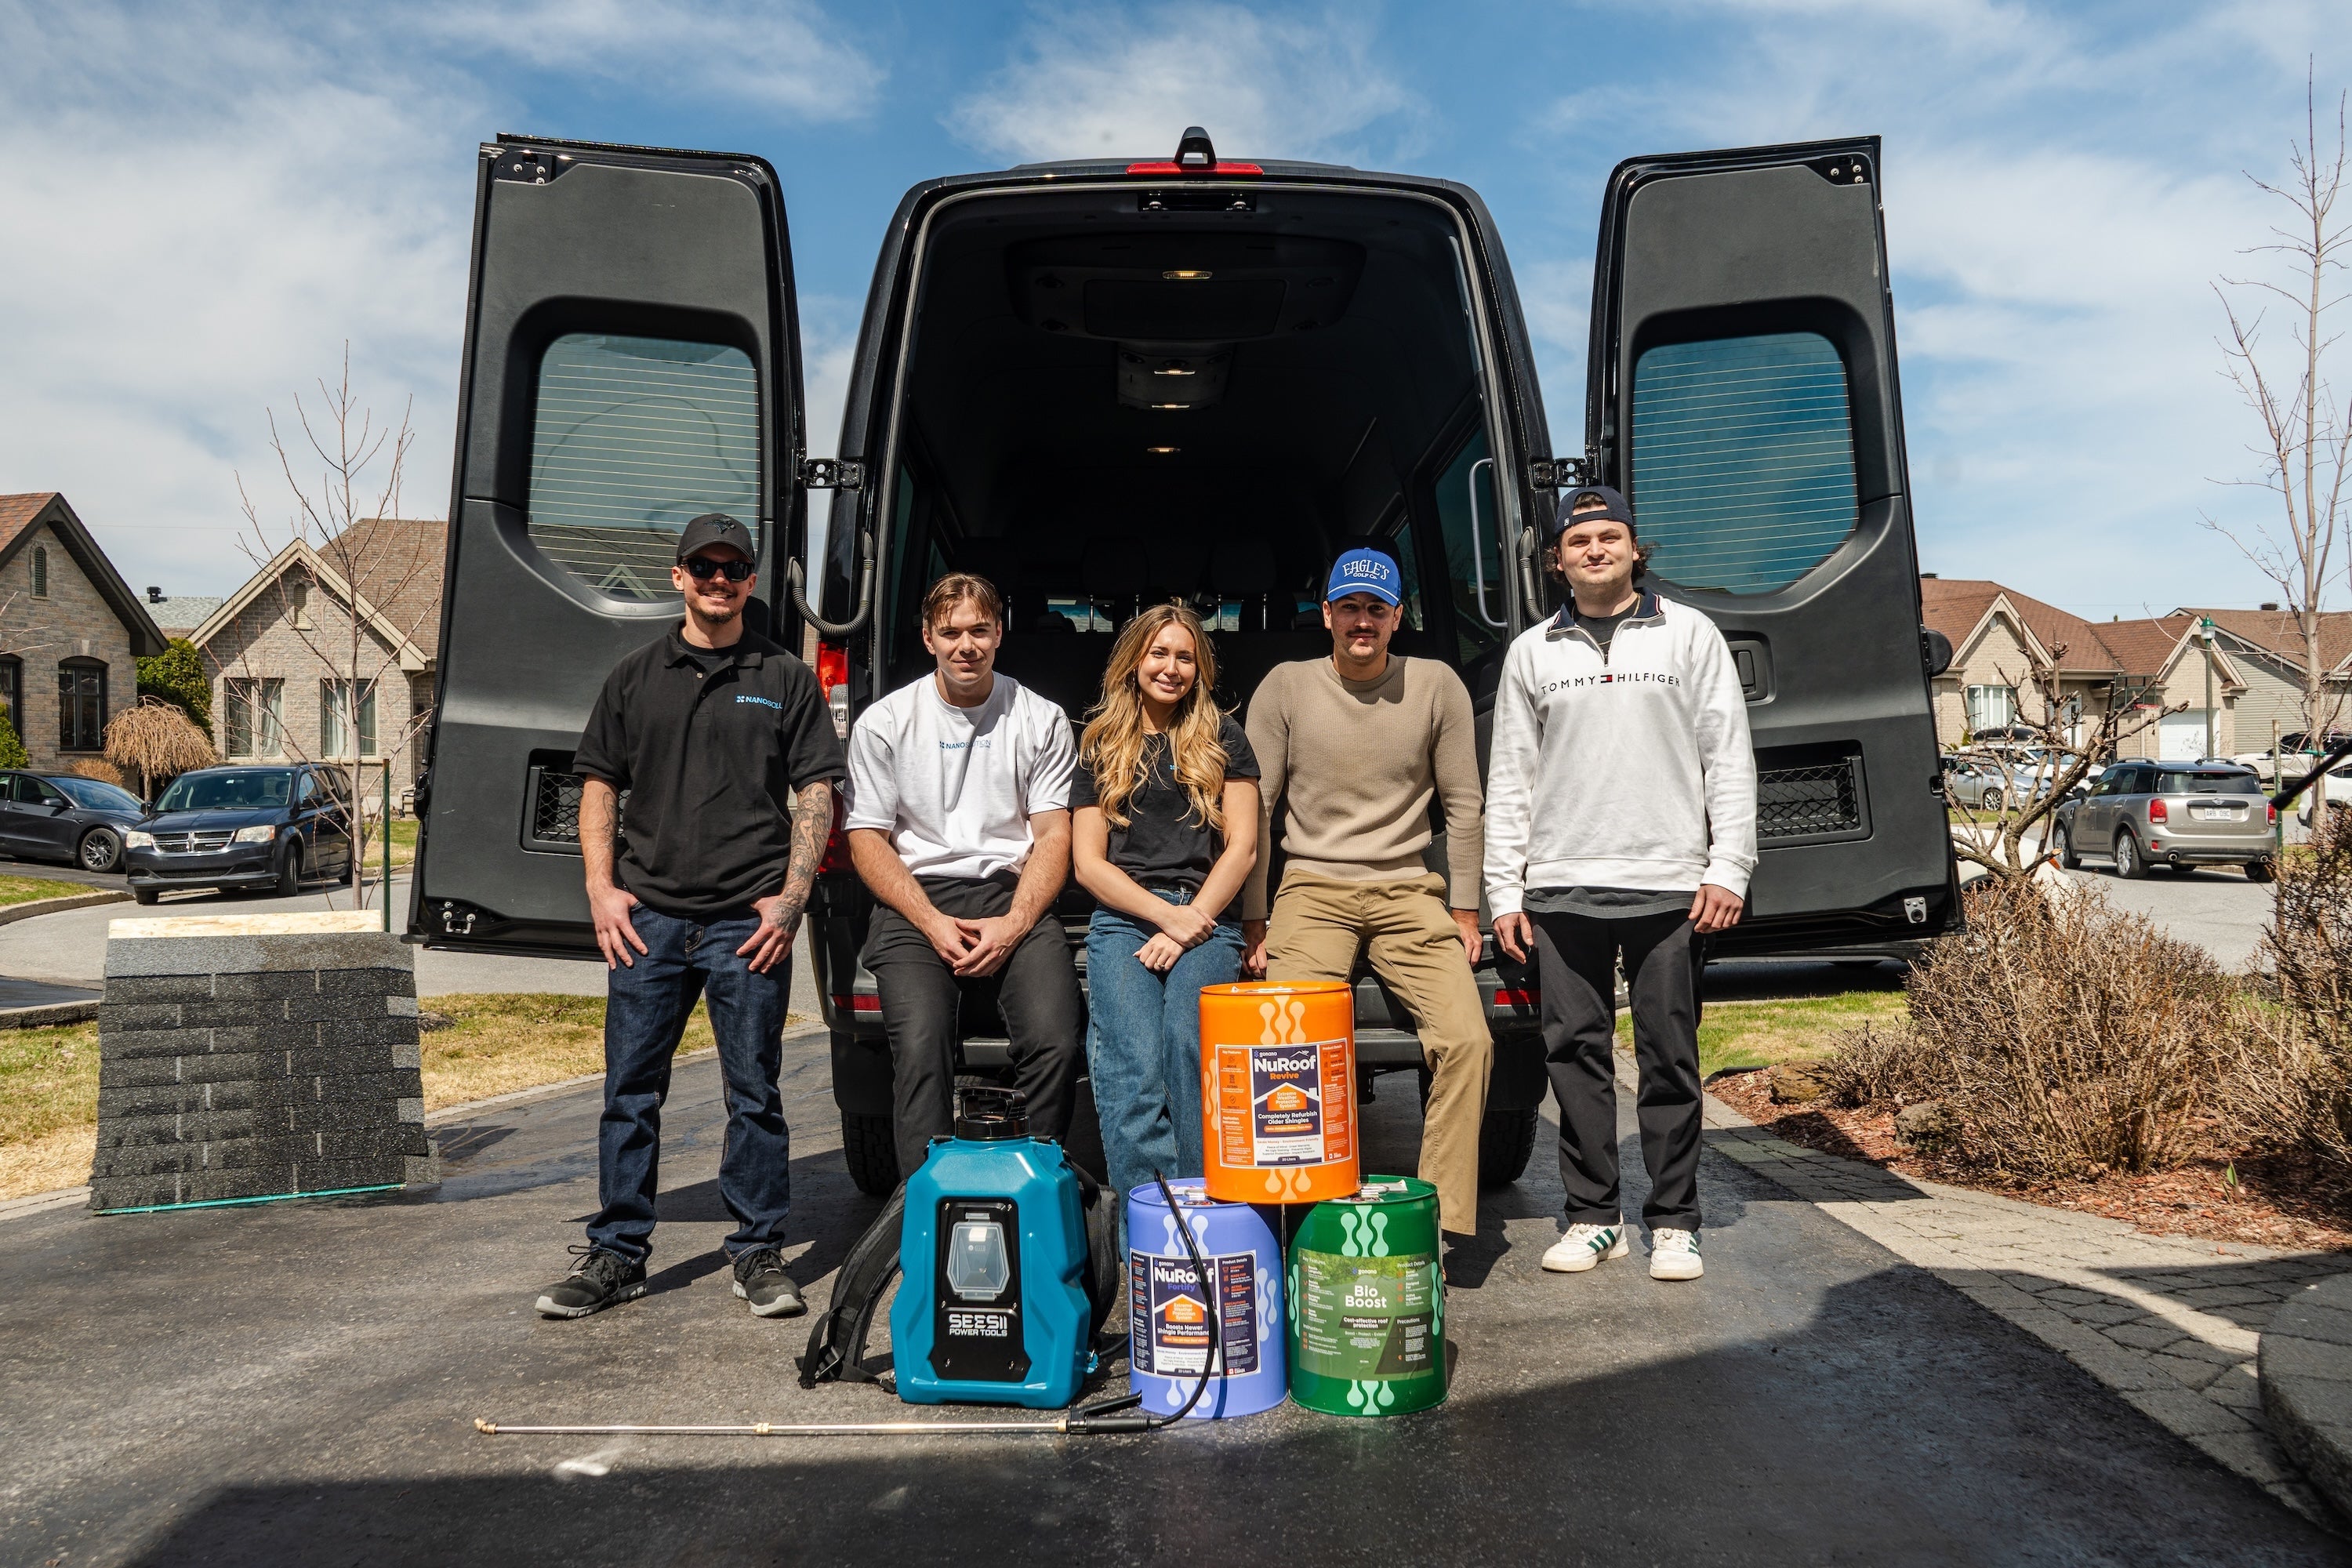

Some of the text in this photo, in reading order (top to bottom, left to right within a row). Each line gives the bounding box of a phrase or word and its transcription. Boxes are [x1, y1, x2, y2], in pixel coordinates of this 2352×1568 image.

[1342, 559, 1390, 580] EAGLE'S
[1541, 673, 1680, 695] TOMMY HILFIGER
[1254, 1055, 1316, 1072] NuRoof
[1154, 1267, 1214, 1283] NuRof
[1167, 1283, 1196, 1292] Fortify
[1355, 1285, 1378, 1297] Bio
[1345, 1295, 1387, 1308] Boost
